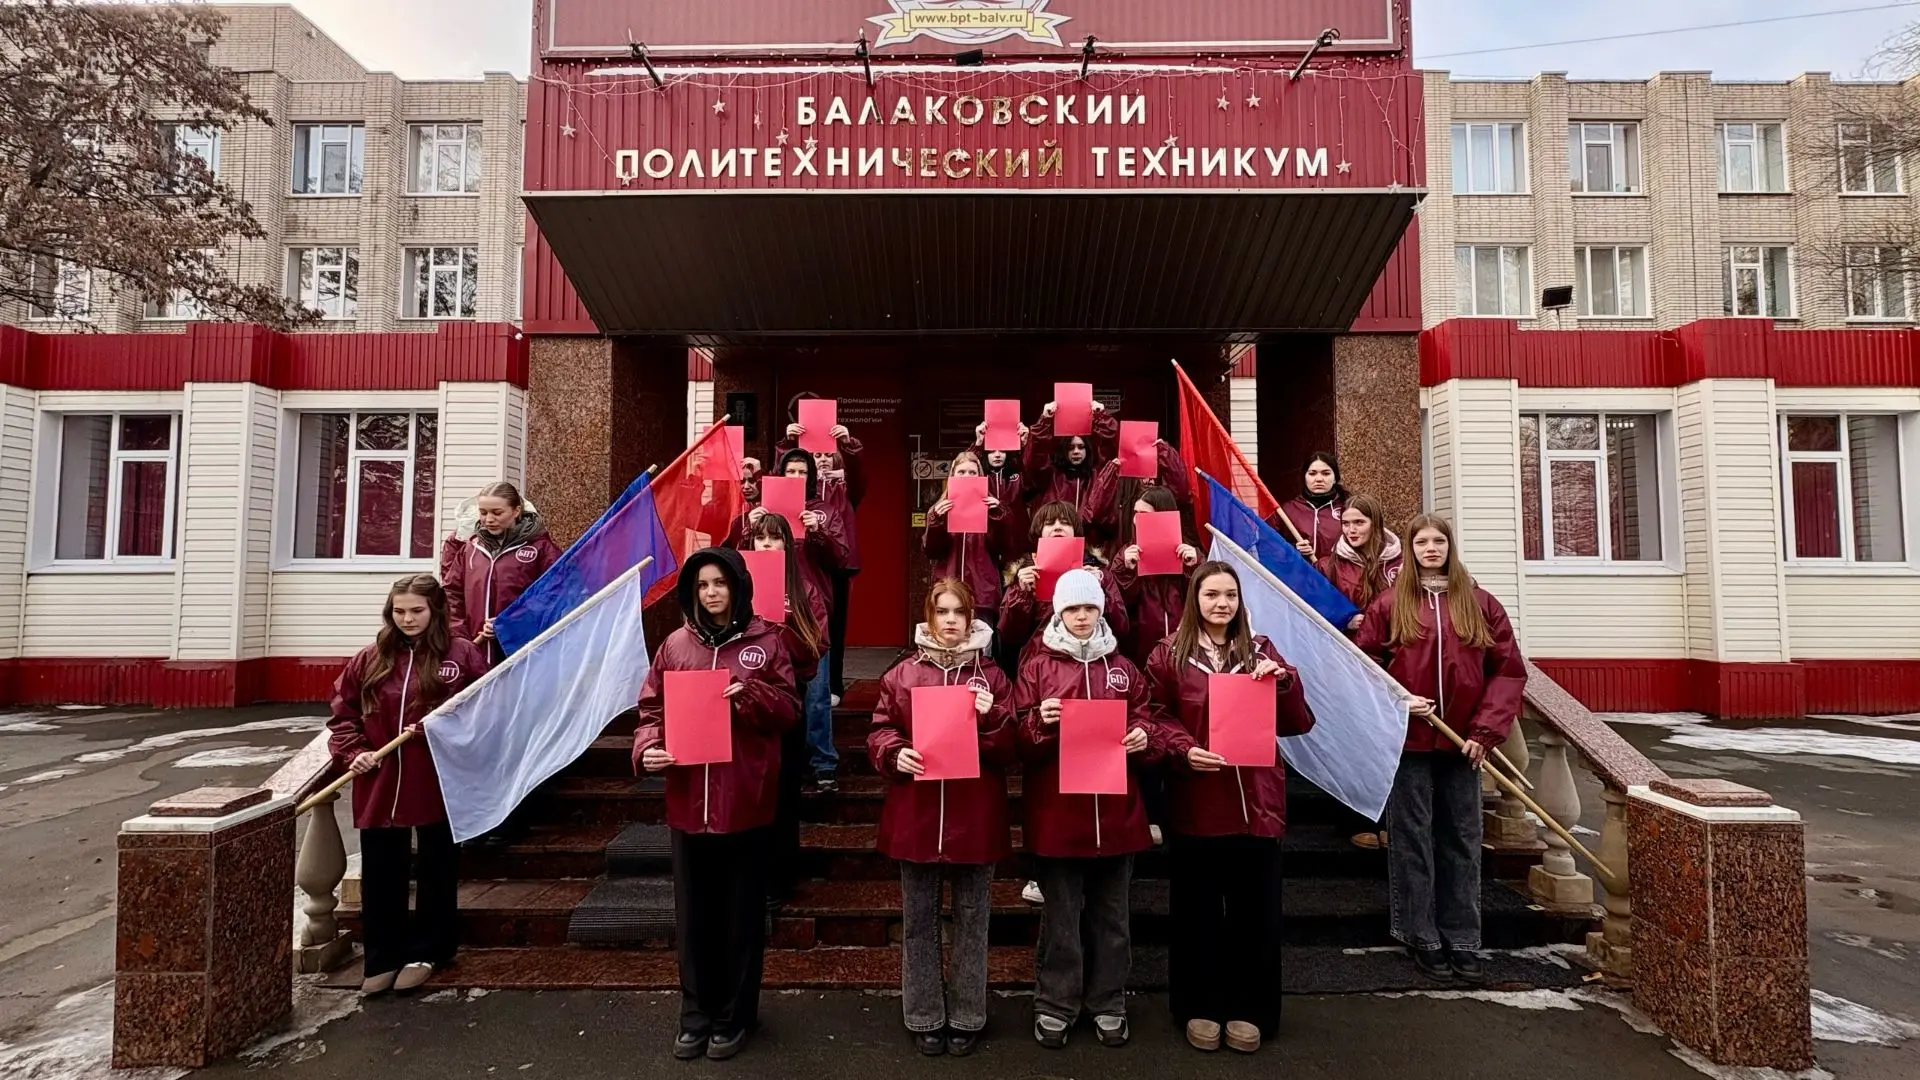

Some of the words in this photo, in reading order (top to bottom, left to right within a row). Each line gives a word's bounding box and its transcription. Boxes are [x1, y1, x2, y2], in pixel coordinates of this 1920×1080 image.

[915, 13, 1023, 25] www.bpt-balv.ru
[616, 139, 1063, 179] ПОЛИТЕХНИЧЕСКИЙ
[1091, 147, 1328, 177] ТЕХНИКУМ
[518, 549, 536, 558] БПТ
[742, 651, 764, 664] БПТ
